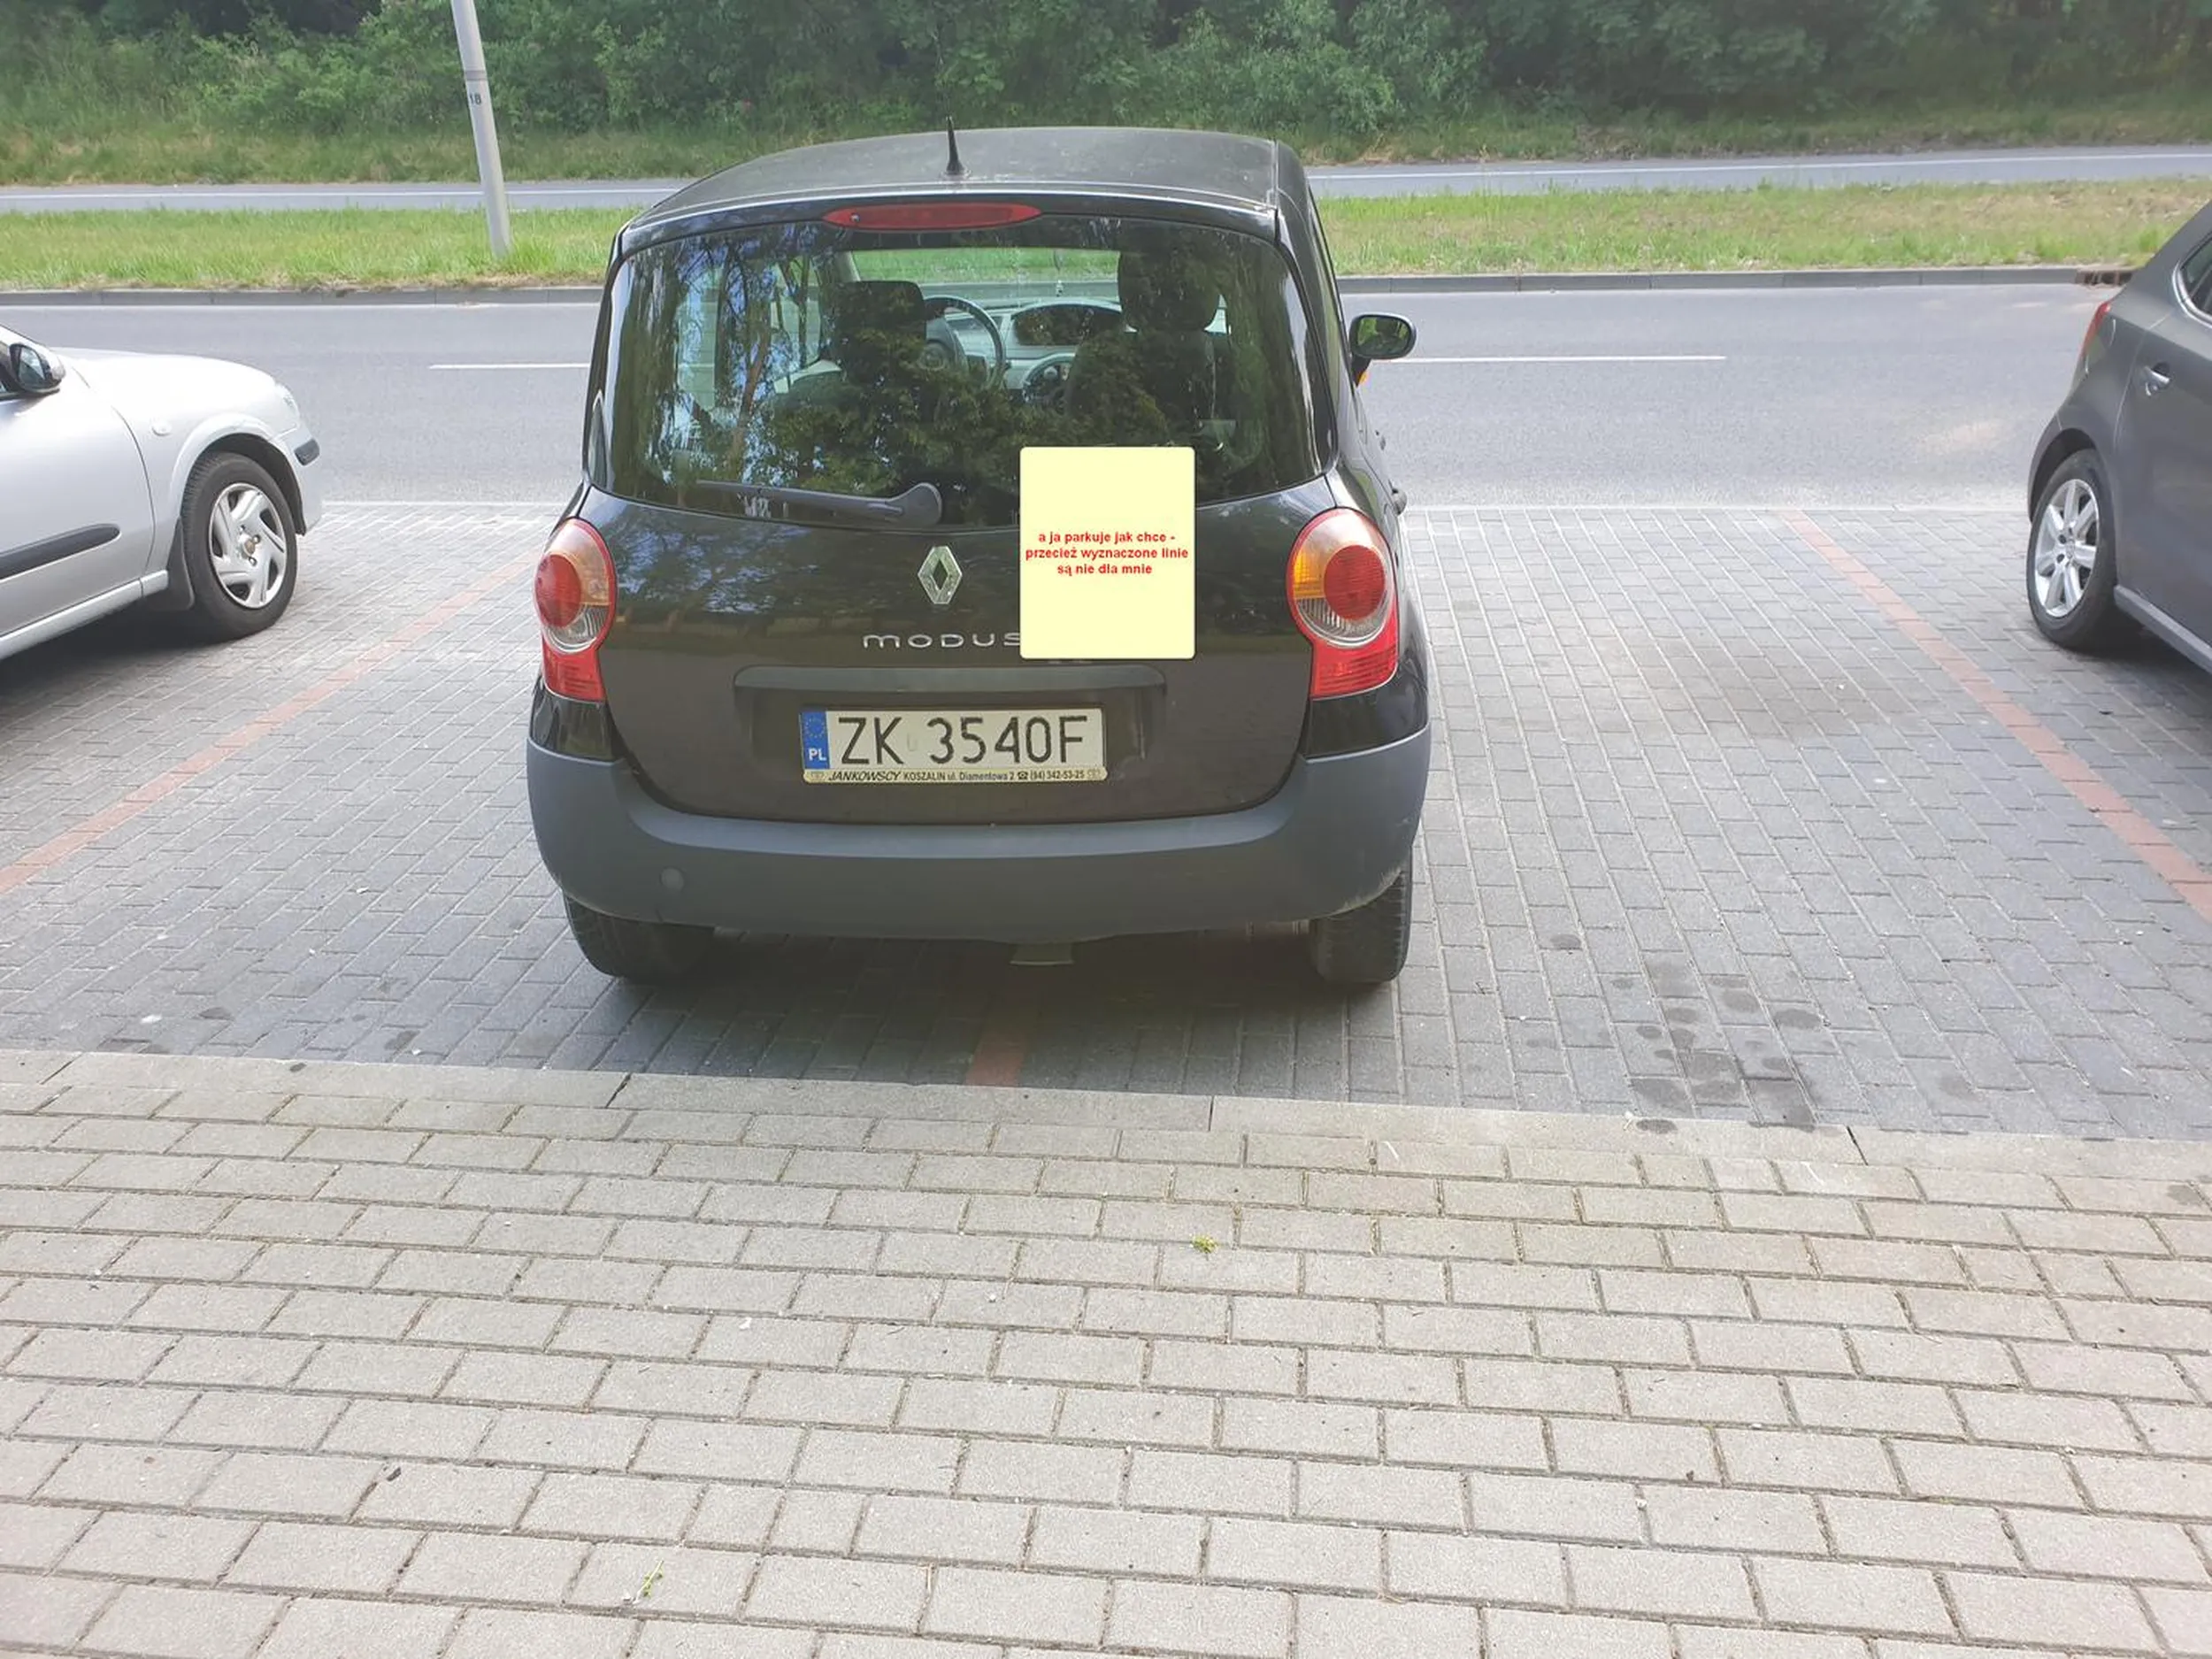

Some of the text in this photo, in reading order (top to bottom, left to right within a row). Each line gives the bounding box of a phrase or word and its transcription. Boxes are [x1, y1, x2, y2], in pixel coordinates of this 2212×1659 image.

[862, 632, 1021, 649] MODUS
[838, 714, 1088, 765] ZK 3540F
[808, 748, 827, 761] PL
[828, 771, 902, 781] JANKOWSCY
[904, 771, 946, 781] KOSZALIN
[959, 771, 1009, 780] Diamentowa
